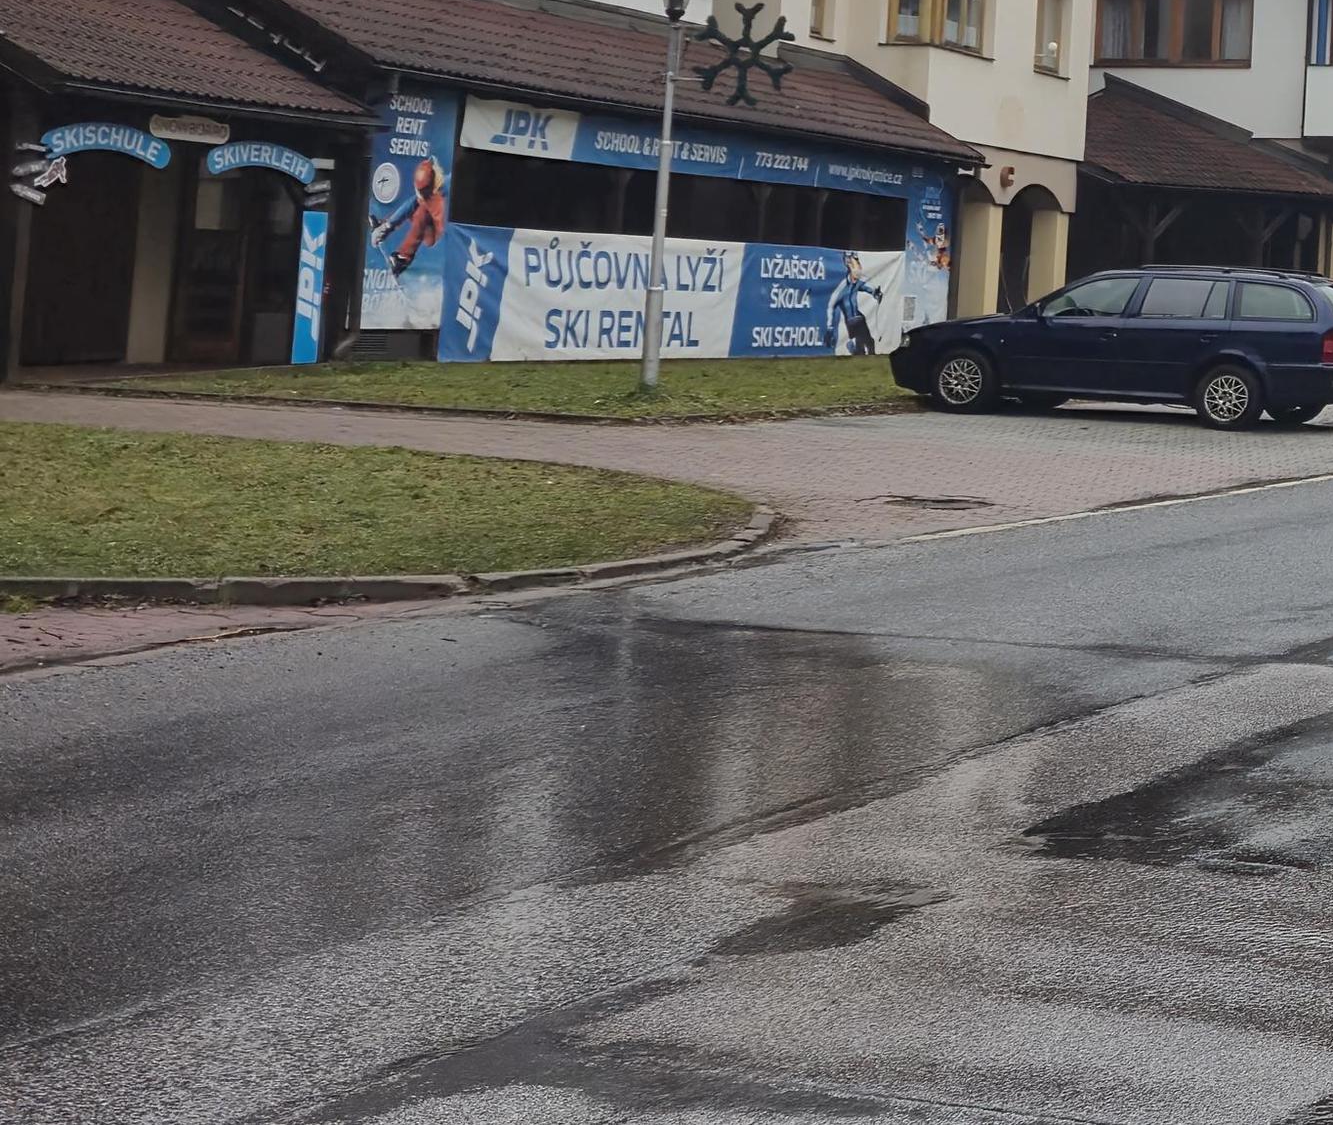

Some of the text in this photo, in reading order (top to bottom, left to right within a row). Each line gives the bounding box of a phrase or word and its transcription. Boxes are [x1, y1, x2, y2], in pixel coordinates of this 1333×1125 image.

[390, 92, 433, 115] SCHOOL
[396, 116, 428, 136] RENT
[490, 108, 553, 151] JPK
[51, 126, 161, 162] SKISCHULE
[389, 137, 430, 157] SERVIS
[595, 131, 641, 155] SCHOOL
[651, 139, 682, 158] RT
[690, 143, 728, 164] SERVIS
[213, 144, 310, 180] SKIVERLEIH
[755, 151, 809, 172] 773 222 744
[524, 237, 727, 293] PŮJČOVNA LYŽÍ
[760, 254, 826, 280] LYŽAŘSKÁ
[297, 227, 327, 342] JPK
[456, 237, 494, 353] JPK
[769, 283, 810, 309] ŠKOLA
[544, 308, 590, 349] SKI
[751, 326, 824, 348] SKI SCHOOL
